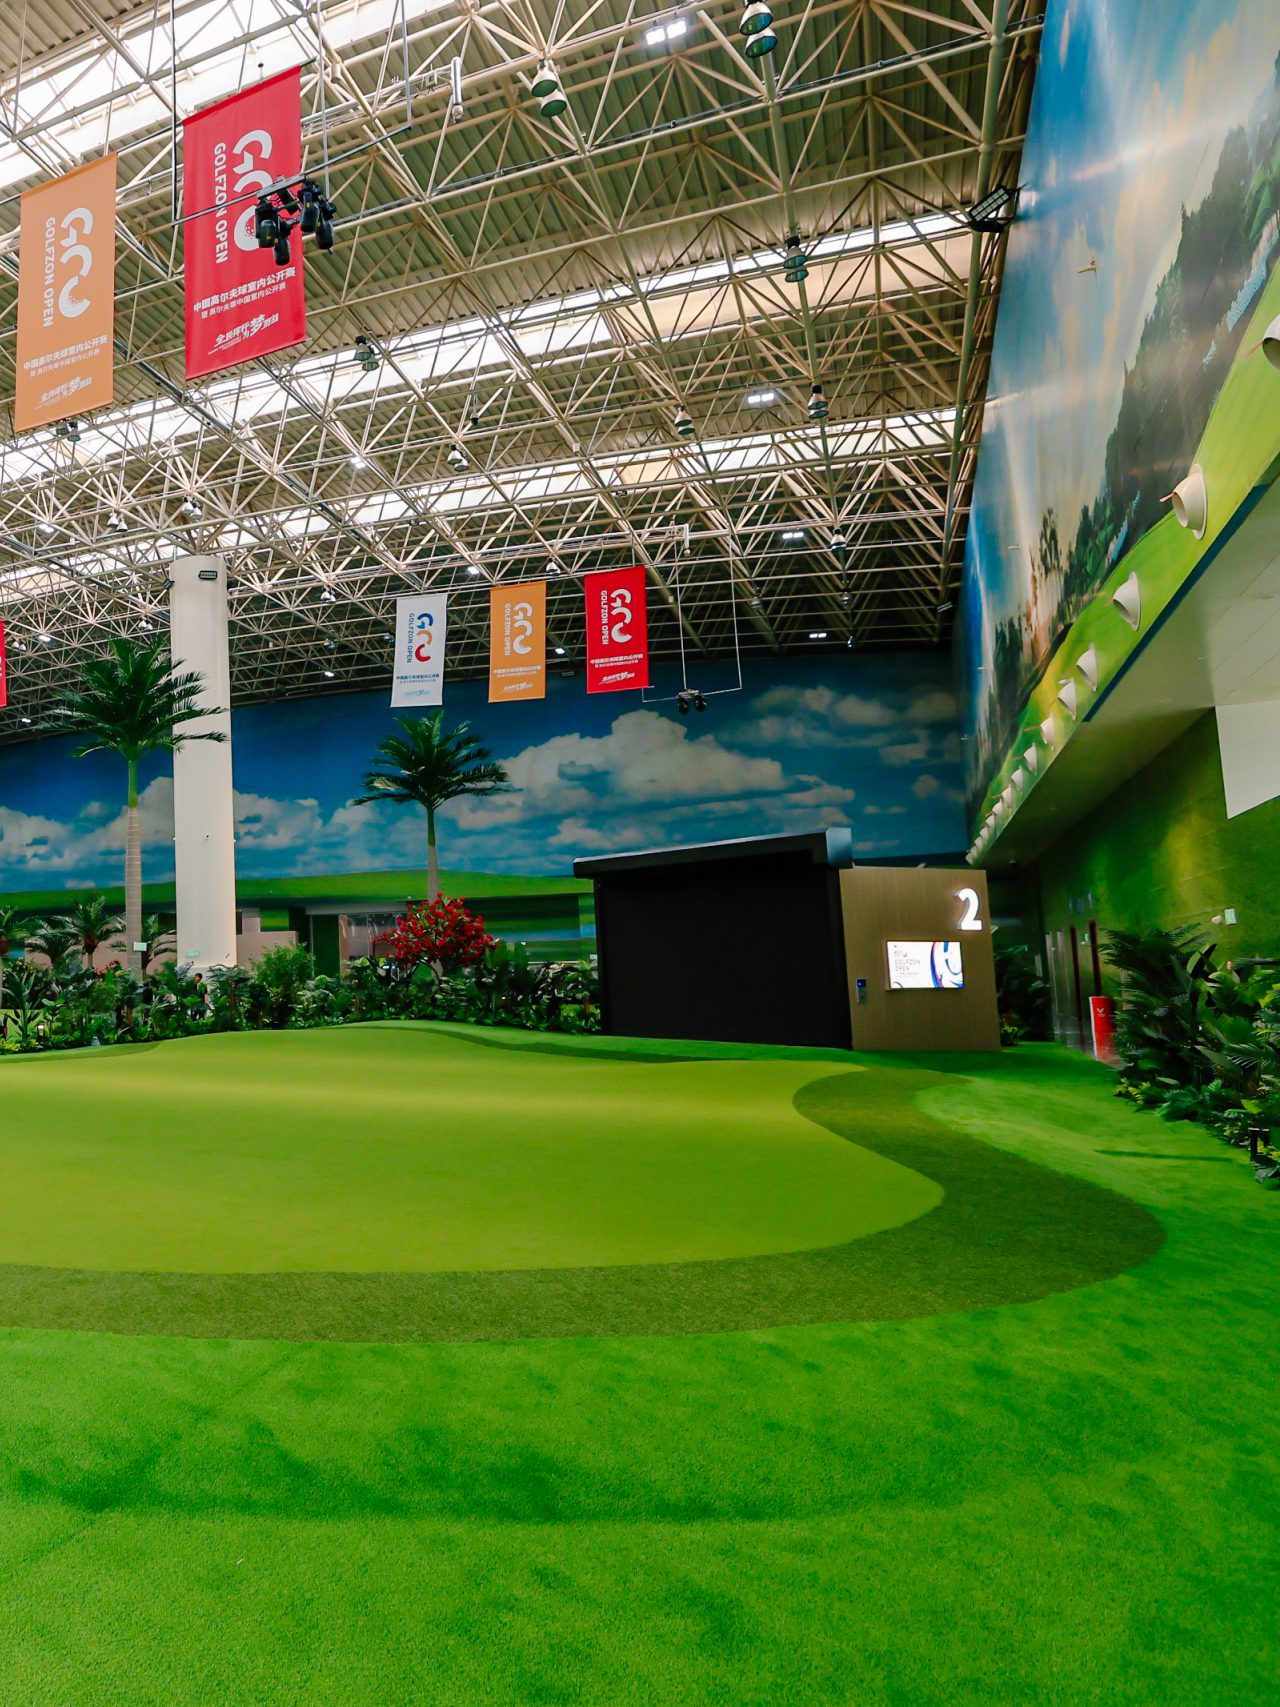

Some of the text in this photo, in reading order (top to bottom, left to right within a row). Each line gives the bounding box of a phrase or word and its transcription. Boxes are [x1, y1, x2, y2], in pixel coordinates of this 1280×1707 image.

[213, 142, 229, 264] GOLFZON OPEN
[43, 216, 56, 328] GOLFZON OPEN
[193, 266, 296, 313] 中国高尔夫球室内公开赛
[406, 612, 415, 663] GOLFZON OPEN
[600, 590, 609, 645] GOLFZON OPEN
[955, 887, 983, 931] 2
